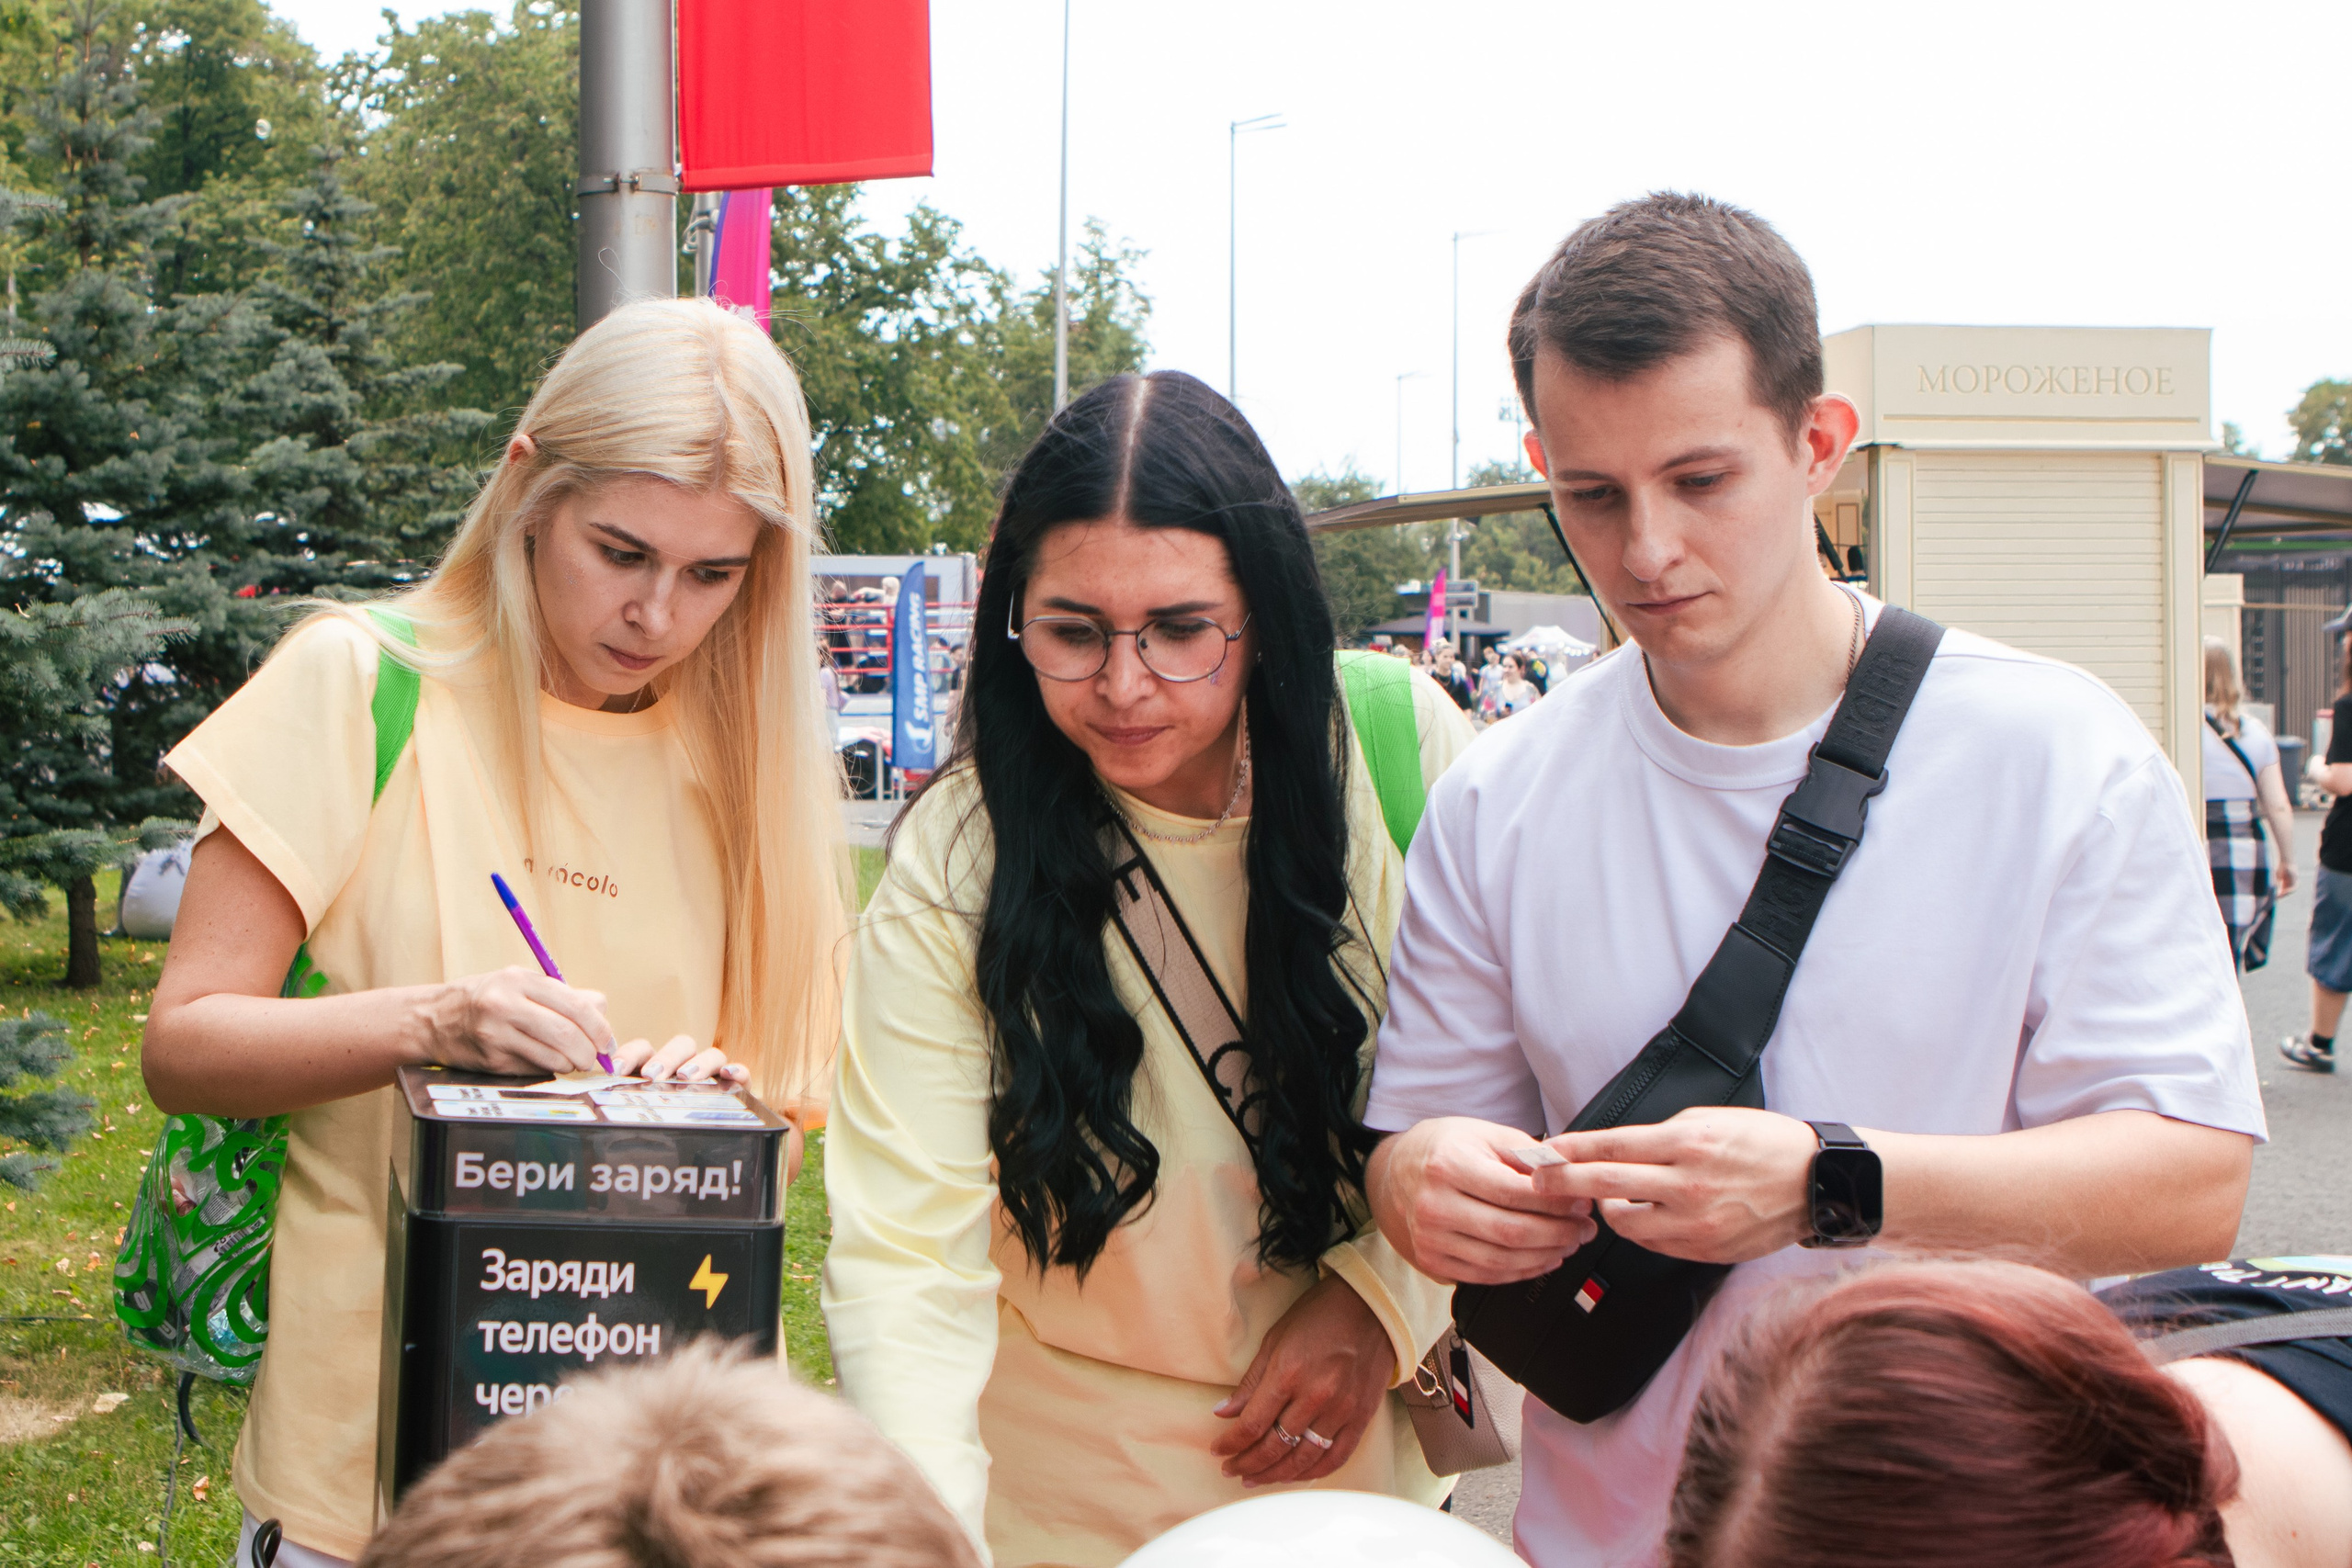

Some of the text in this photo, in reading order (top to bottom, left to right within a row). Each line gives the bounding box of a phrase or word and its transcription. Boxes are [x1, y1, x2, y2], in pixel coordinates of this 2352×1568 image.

[1917, 365, 2175, 396] МОРОЖЕНОЕ
[909, 592, 926, 671] RACING
[455, 1152, 742, 1200] Бери заряд!
[481, 1247, 636, 1299] Заряди
[477, 1313, 662, 1362] телефон
